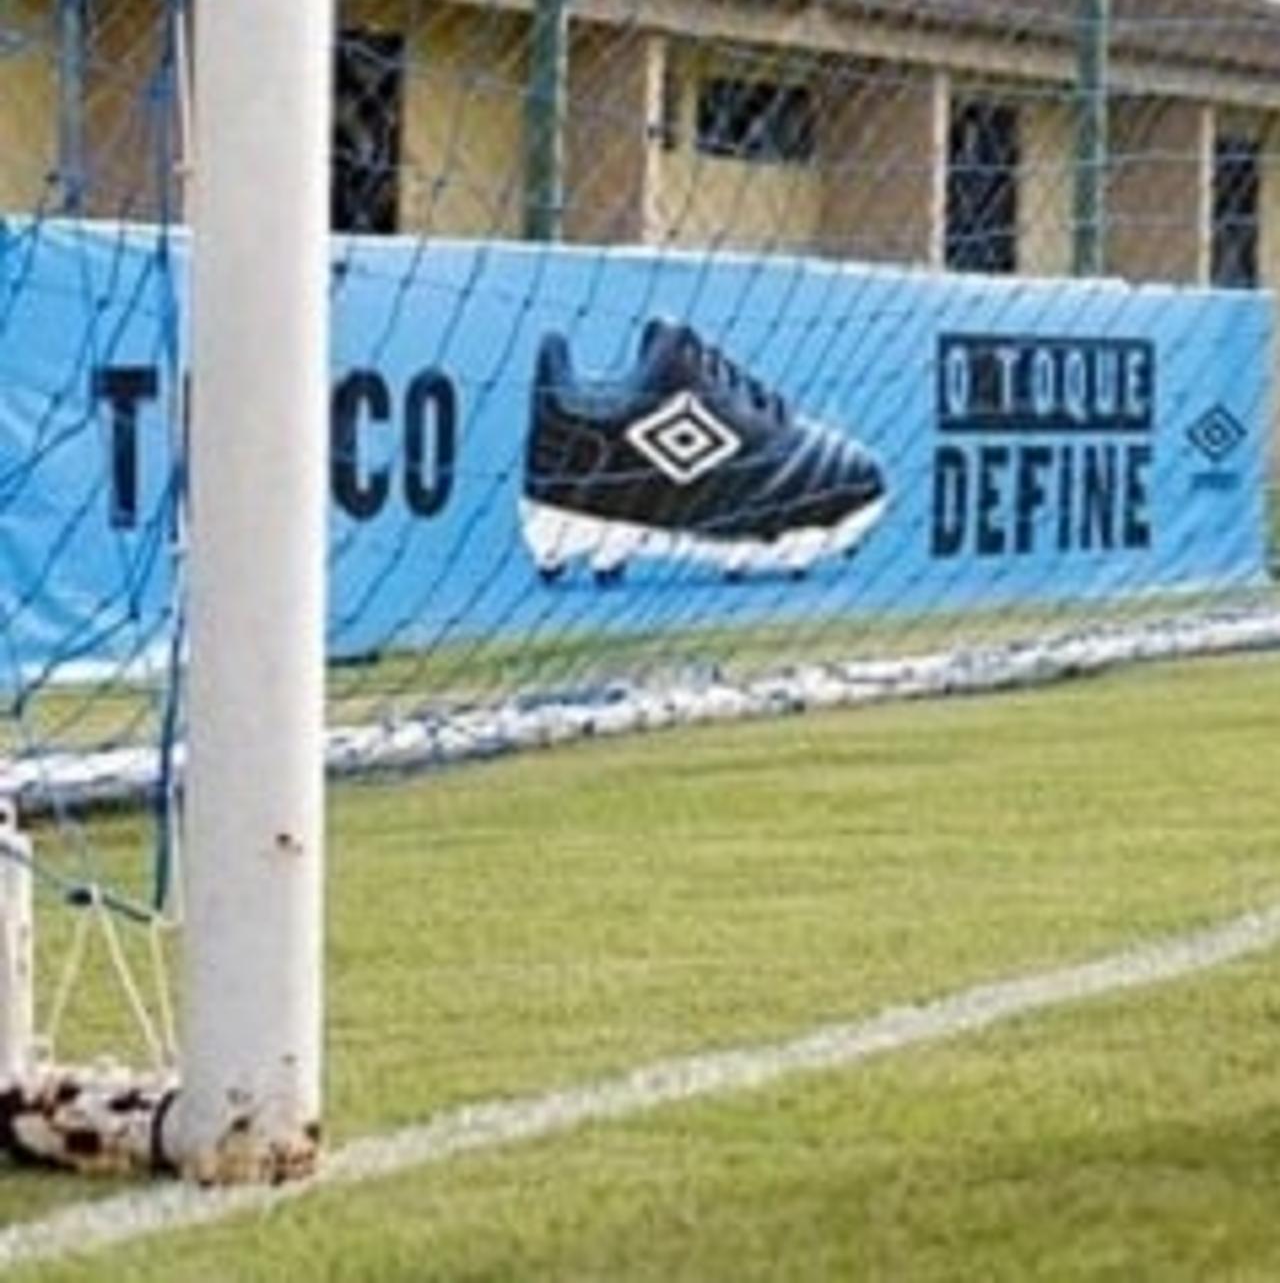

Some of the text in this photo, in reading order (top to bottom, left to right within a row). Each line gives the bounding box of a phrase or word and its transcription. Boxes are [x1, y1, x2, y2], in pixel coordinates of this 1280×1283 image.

[946, 344, 1146, 422] O TOQUE
[91, 363, 457, 530] TCO
[930, 446, 1153, 558] DEFINE
